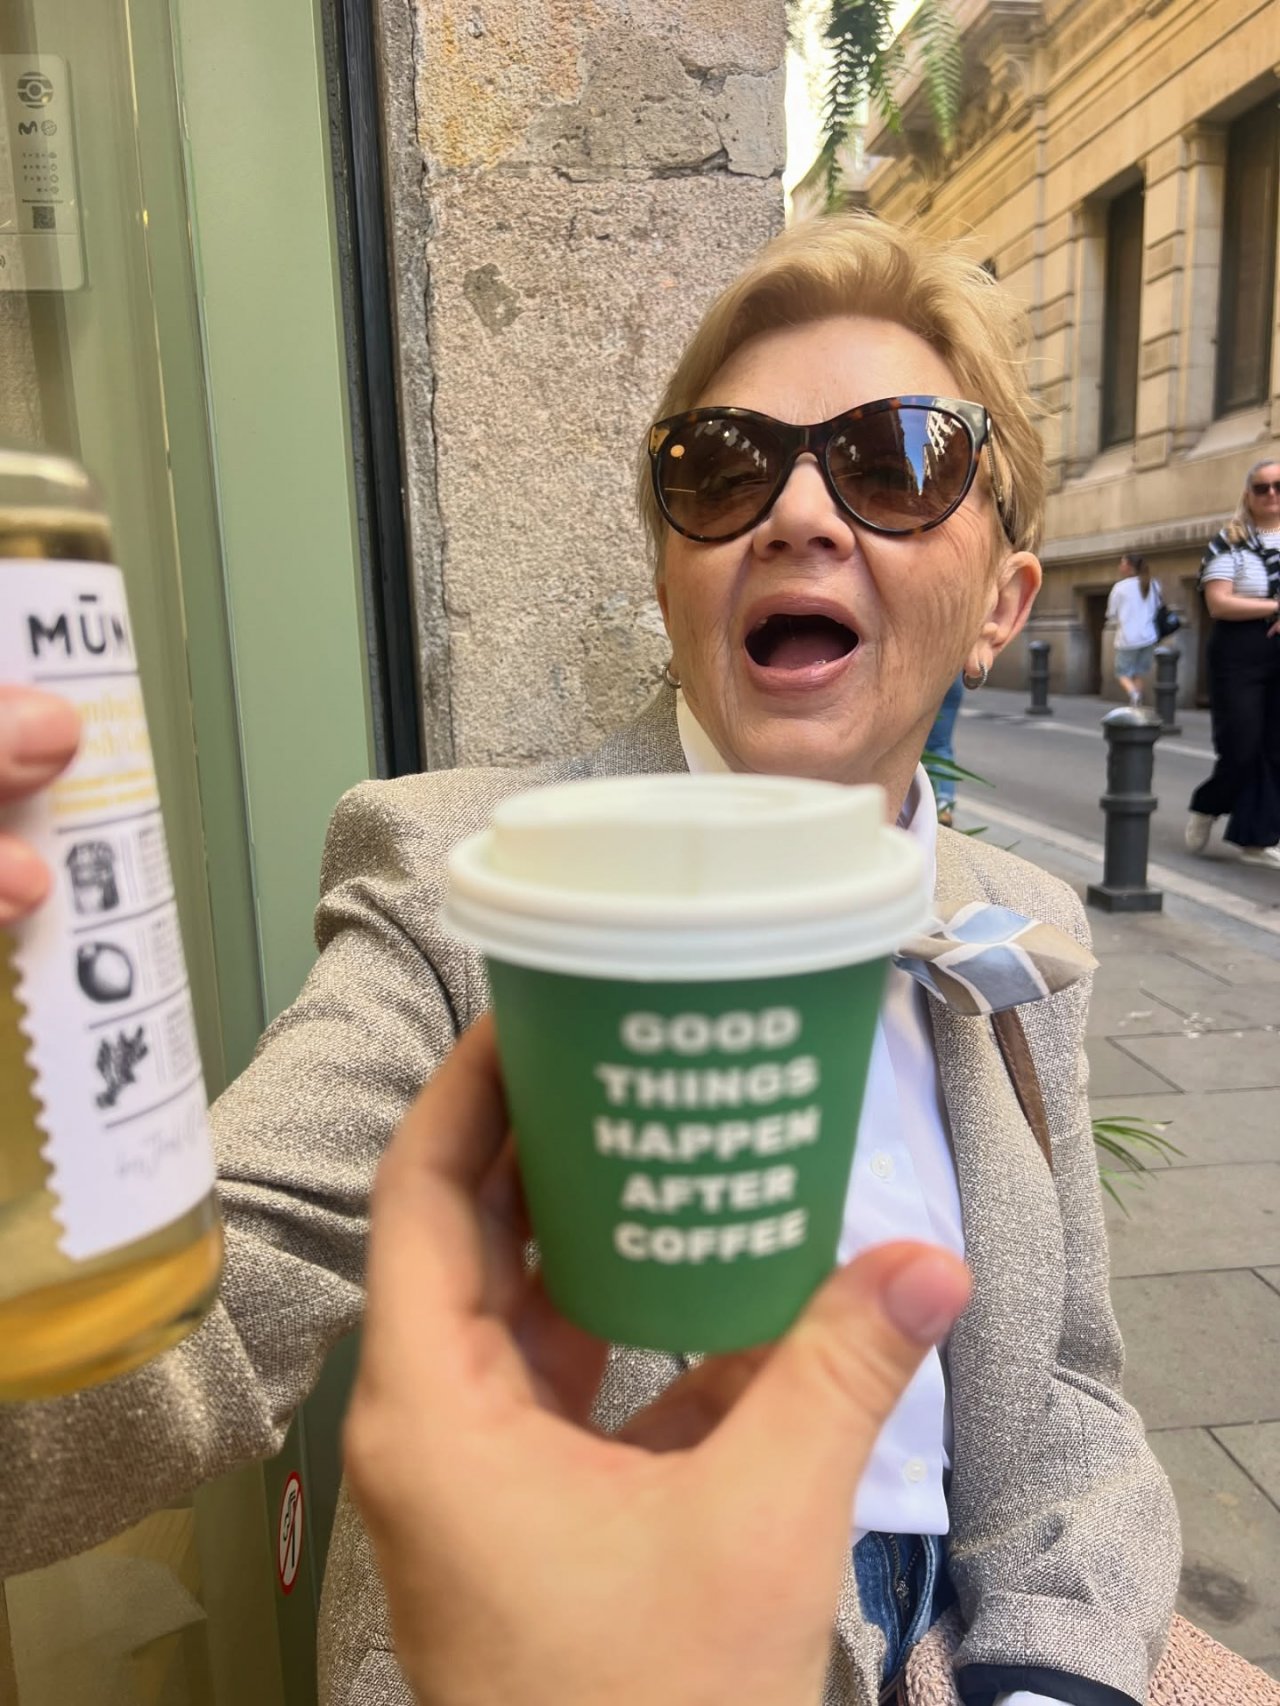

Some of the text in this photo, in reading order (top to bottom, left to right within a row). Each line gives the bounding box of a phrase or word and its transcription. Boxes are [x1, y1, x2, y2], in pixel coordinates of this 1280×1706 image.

[621, 1007, 801, 1053] GOOD
[596, 1055, 819, 1108] THINGS
[595, 1105, 822, 1161] HAPPEN
[622, 1165, 798, 1212] AFTER
[614, 1208, 808, 1264] COFFEE
